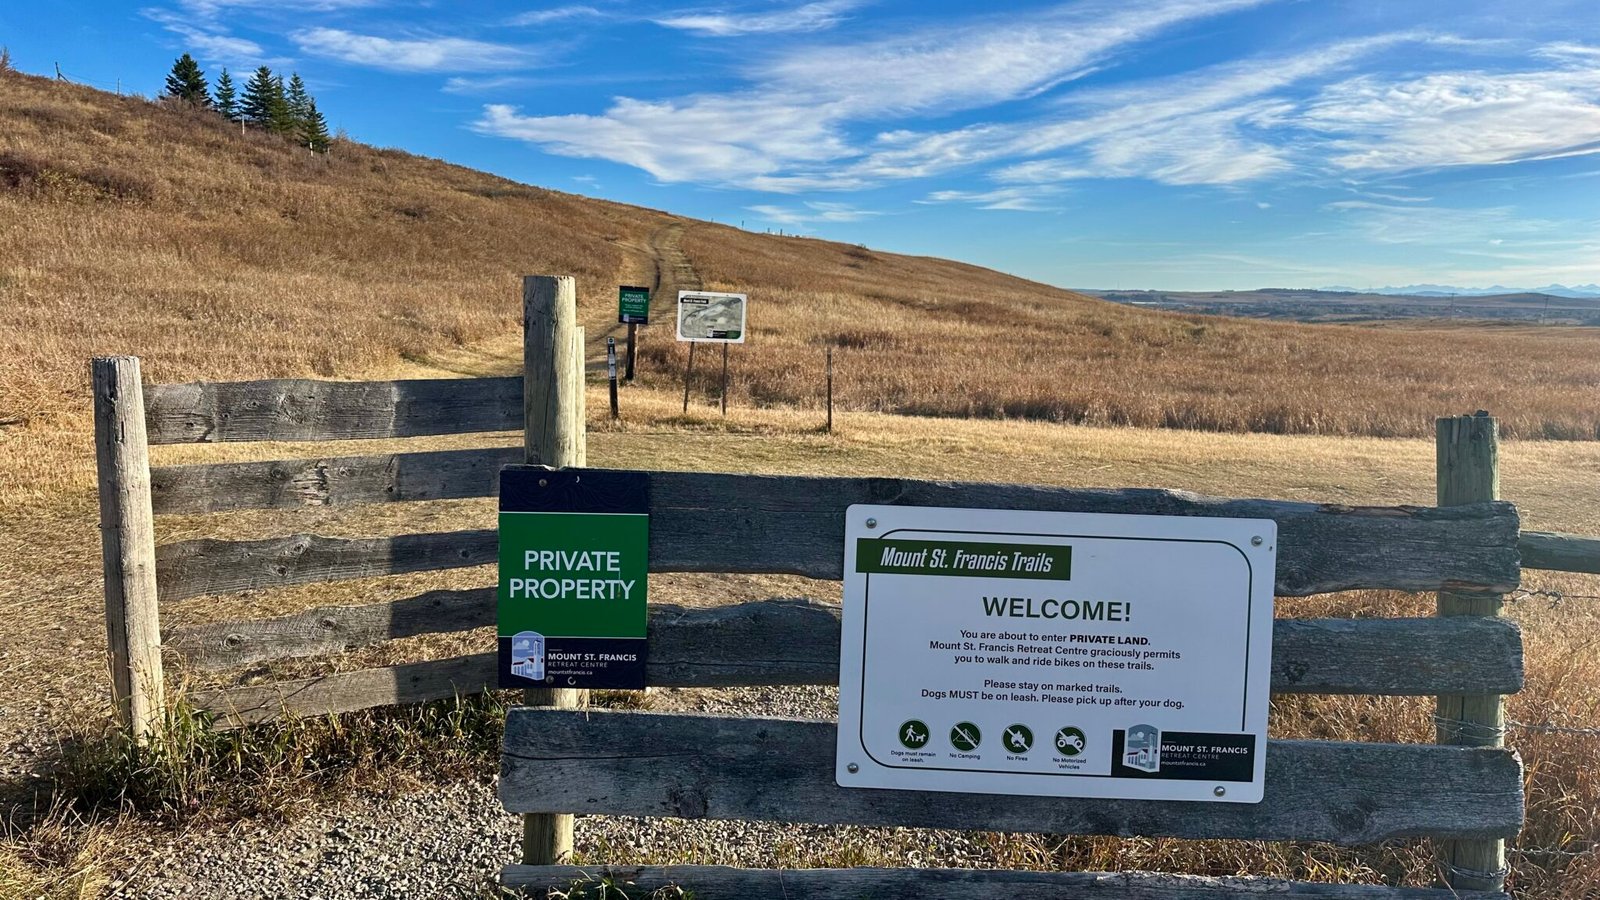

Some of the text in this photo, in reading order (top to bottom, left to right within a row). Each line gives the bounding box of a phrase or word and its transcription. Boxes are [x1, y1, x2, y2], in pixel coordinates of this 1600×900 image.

[524, 550, 621, 572] PRIVATE
[880, 546, 1053, 573] Mount St. Francis Trails
[509, 578, 636, 600] PROPERTY
[982, 596, 1131, 622] WELCOME!
[960, 629, 1151, 646] You are about to enter PRIVATE LAND.
[548, 653, 637, 662] MOUNT ST. FRANCIS
[929, 640, 1181, 660] Mount St. Francis Retreat Centre graciously permits
[954, 655, 1155, 671] you to walk and ride bikes on these trails.
[984, 679, 1123, 694] Please stay on marked trails.
[921, 689, 947, 700] Dogs
[949, 690, 979, 699] MUST
[981, 691, 994, 700] be
[1010, 693, 1039, 702] leash.
[1041, 694, 1074, 704] Please
[1076, 695, 1097, 706] pick
[1099, 698, 1112, 707] up
[1114, 697, 1137, 706] after
[1138, 700, 1161, 709] your
[1163, 699, 1185, 710] dog.
[1161, 744, 1195, 752] MOUNT
[1211, 746, 1248, 754] FRANCIS
